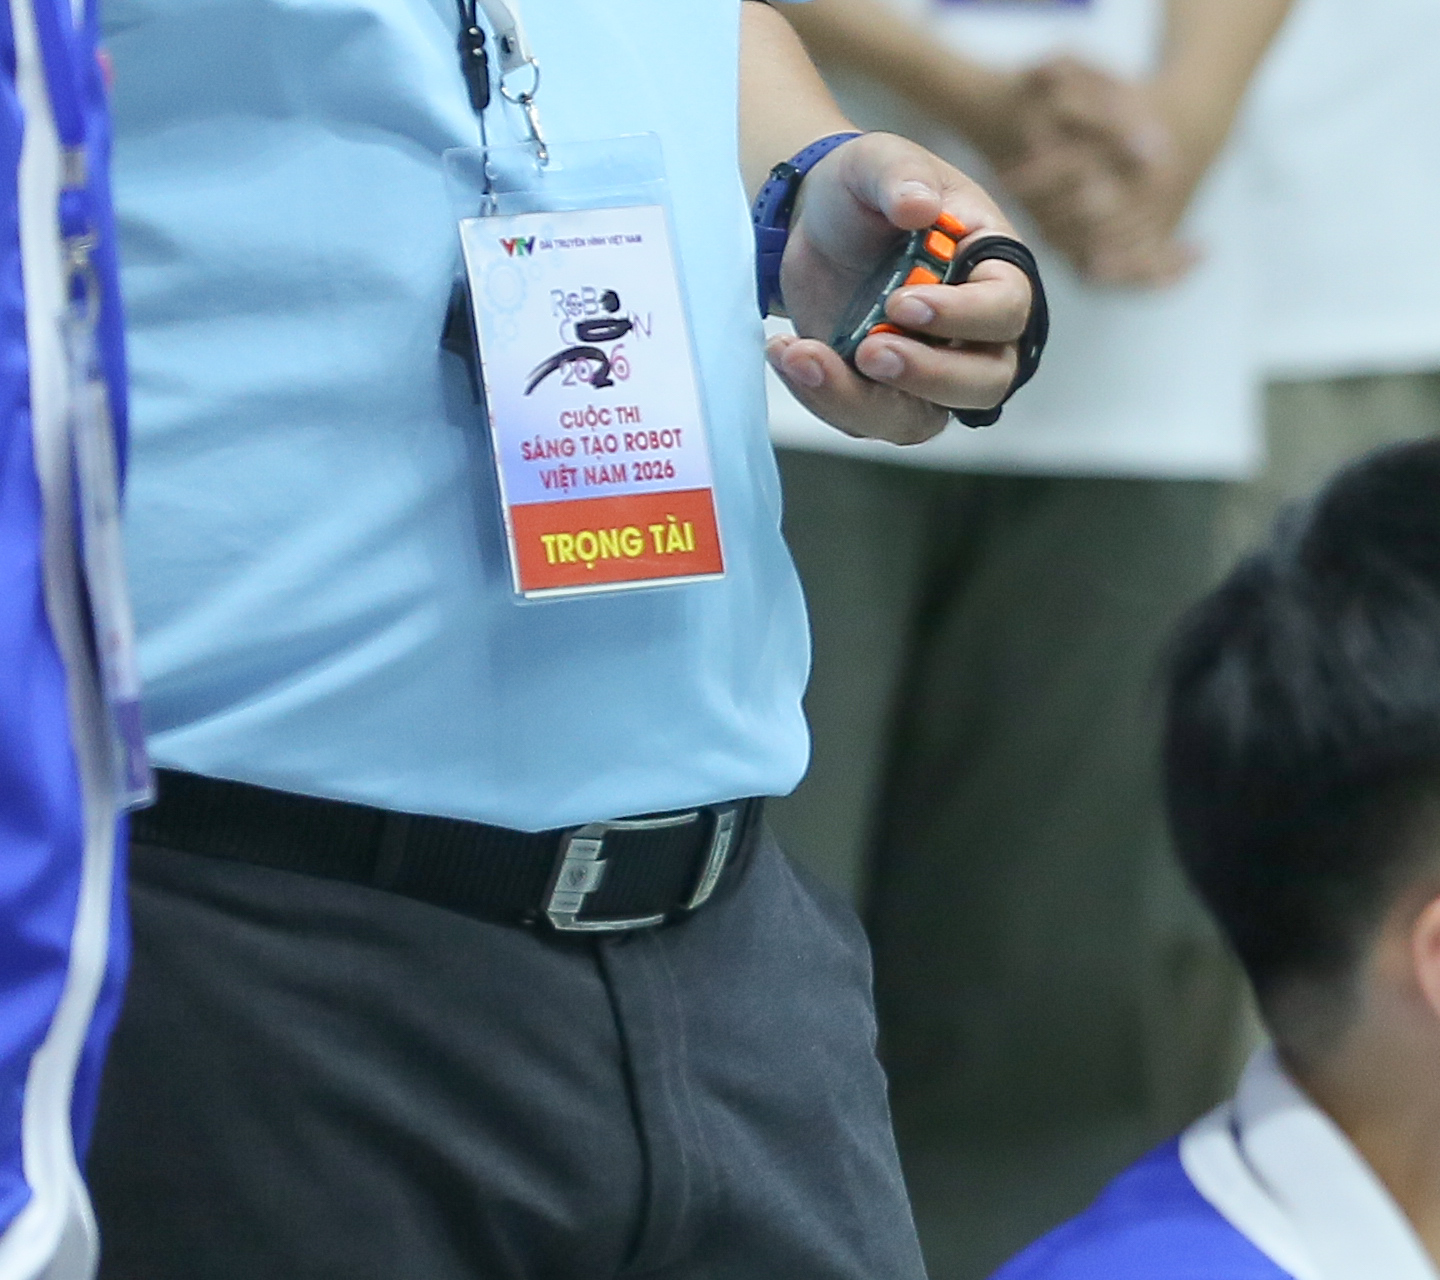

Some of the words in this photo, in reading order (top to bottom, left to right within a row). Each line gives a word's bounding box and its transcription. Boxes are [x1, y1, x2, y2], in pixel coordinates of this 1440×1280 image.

[498, 235, 536, 257] VTV
[559, 404, 612, 431] CUỘC
[614, 405, 642, 424] THI
[520, 434, 576, 461] SÁNG
[579, 433, 619, 460] TẠO
[622, 428, 683, 452] ROBOT
[539, 463, 578, 494] VIỆT
[583, 463, 628, 486] NAM
[632, 459, 677, 482] 2026
[540, 525, 647, 570] TRỌNG
[648, 513, 697, 555] TÀI
